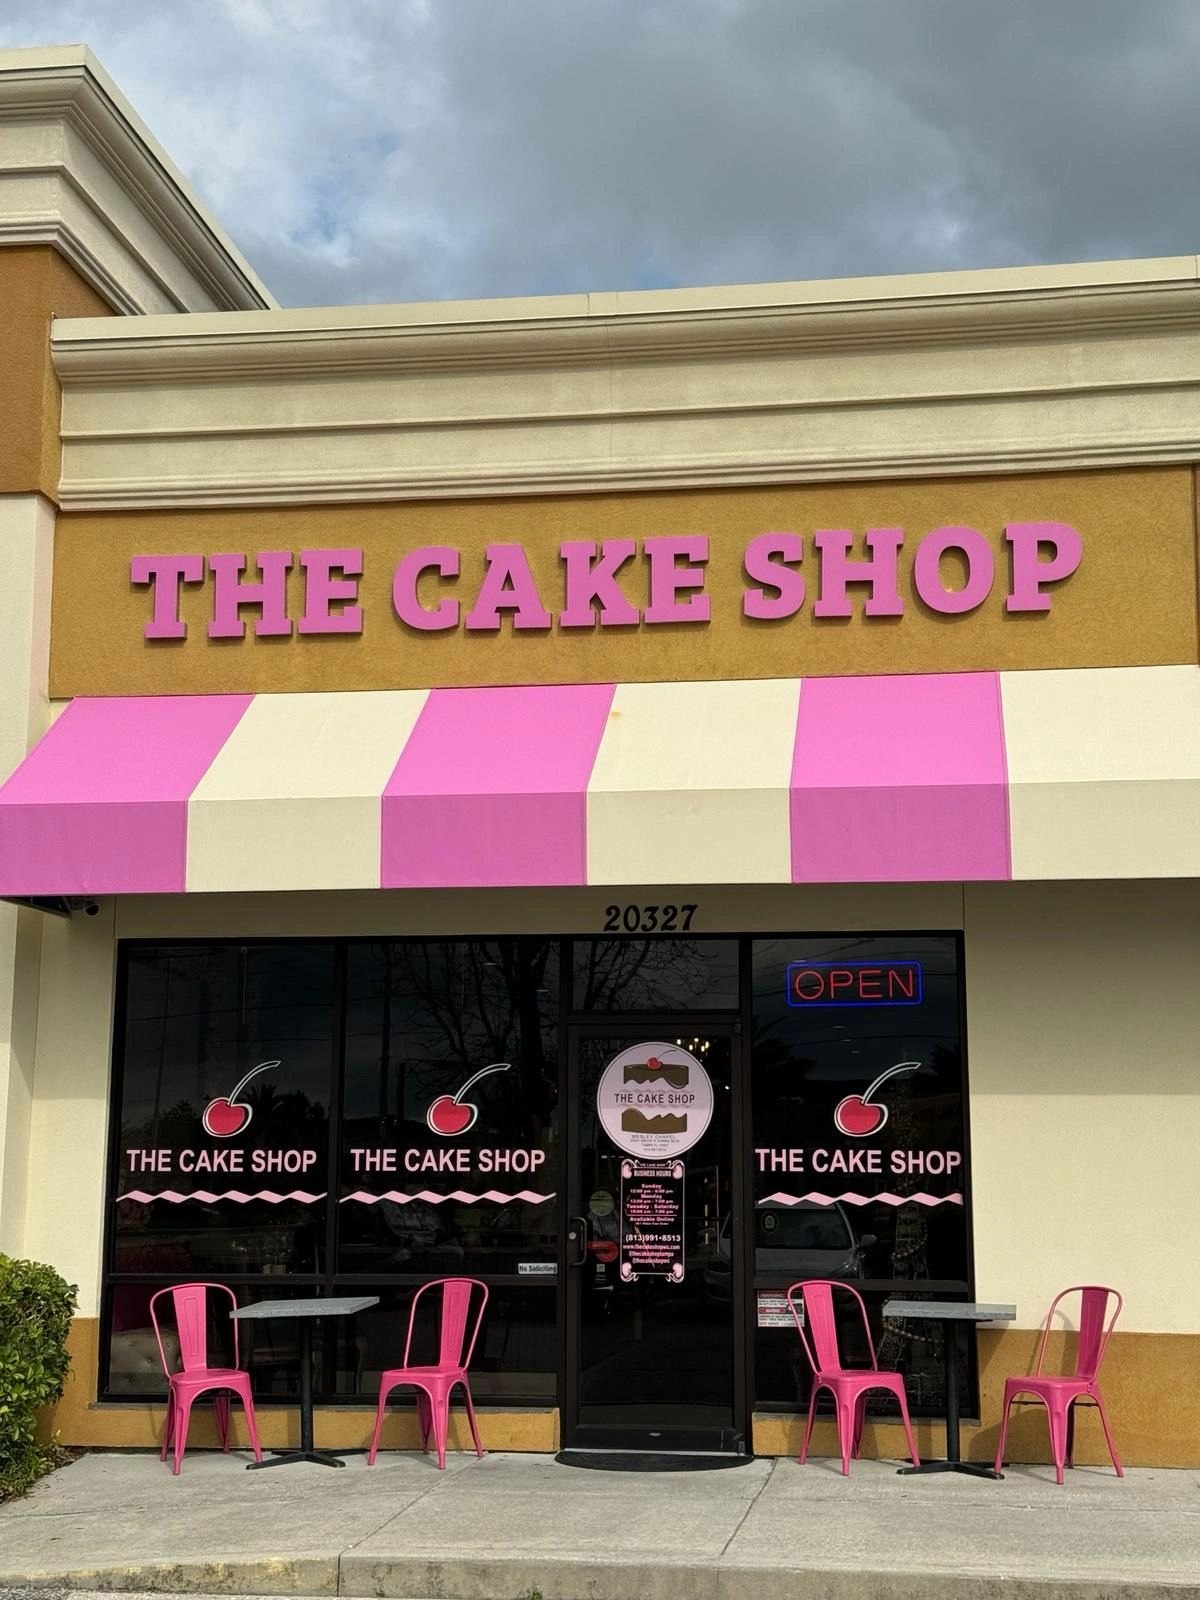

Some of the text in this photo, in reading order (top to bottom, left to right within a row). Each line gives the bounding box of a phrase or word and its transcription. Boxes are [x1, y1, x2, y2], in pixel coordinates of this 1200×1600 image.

[130, 521, 1084, 640] THE CAKE SHOP
[603, 904, 699, 932] 20327
[795, 968, 917, 1000] OPEN
[614, 1093, 695, 1104] THE CAKE SHOP
[126, 1149, 317, 1174] THE CAKE SHOP
[350, 1148, 546, 1173] THE CAKE SHOP
[755, 1149, 962, 1175] THE CAKE SHOP
[528, 1265, 557, 1273] Soliciting
